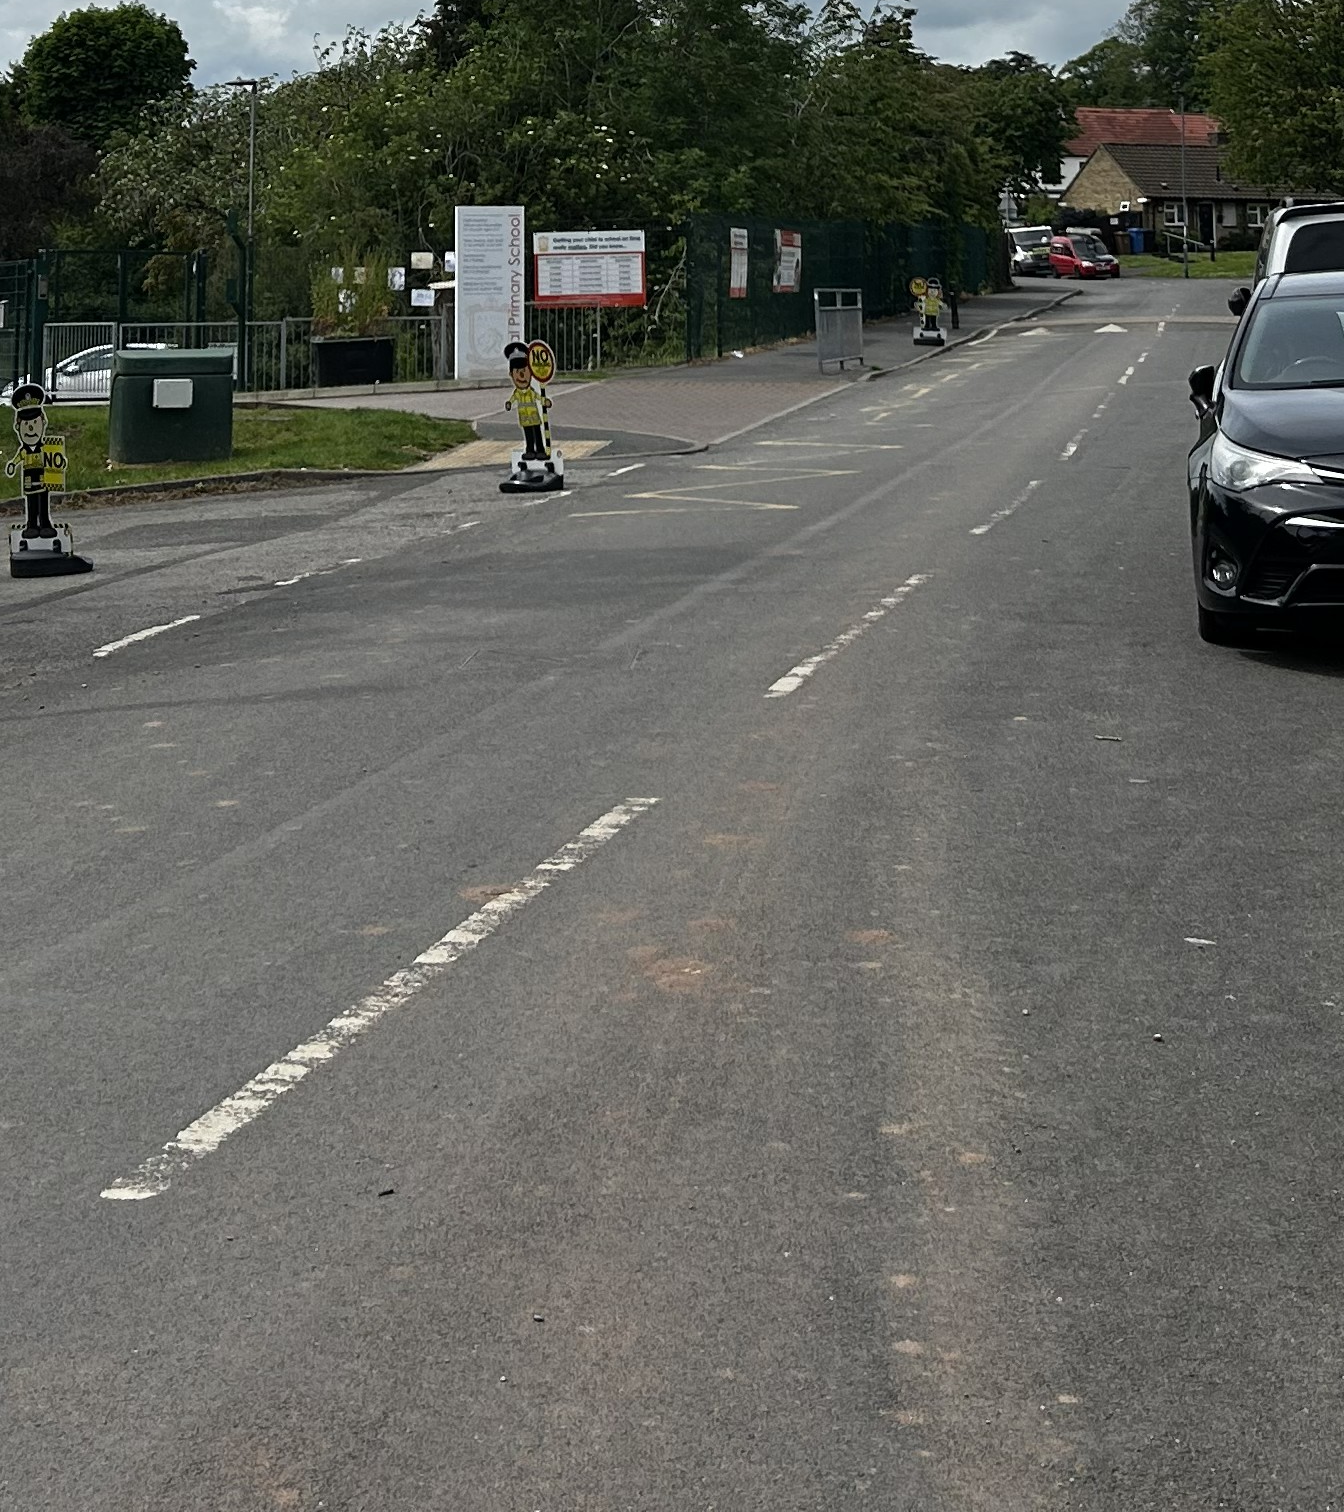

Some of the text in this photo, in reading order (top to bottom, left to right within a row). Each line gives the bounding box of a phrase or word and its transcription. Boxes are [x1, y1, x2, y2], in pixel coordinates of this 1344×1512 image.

[508, 213, 520, 266] School
[508, 270, 522, 326] Primary
[532, 349, 548, 363] NO
[43, 452, 63, 468] NO
